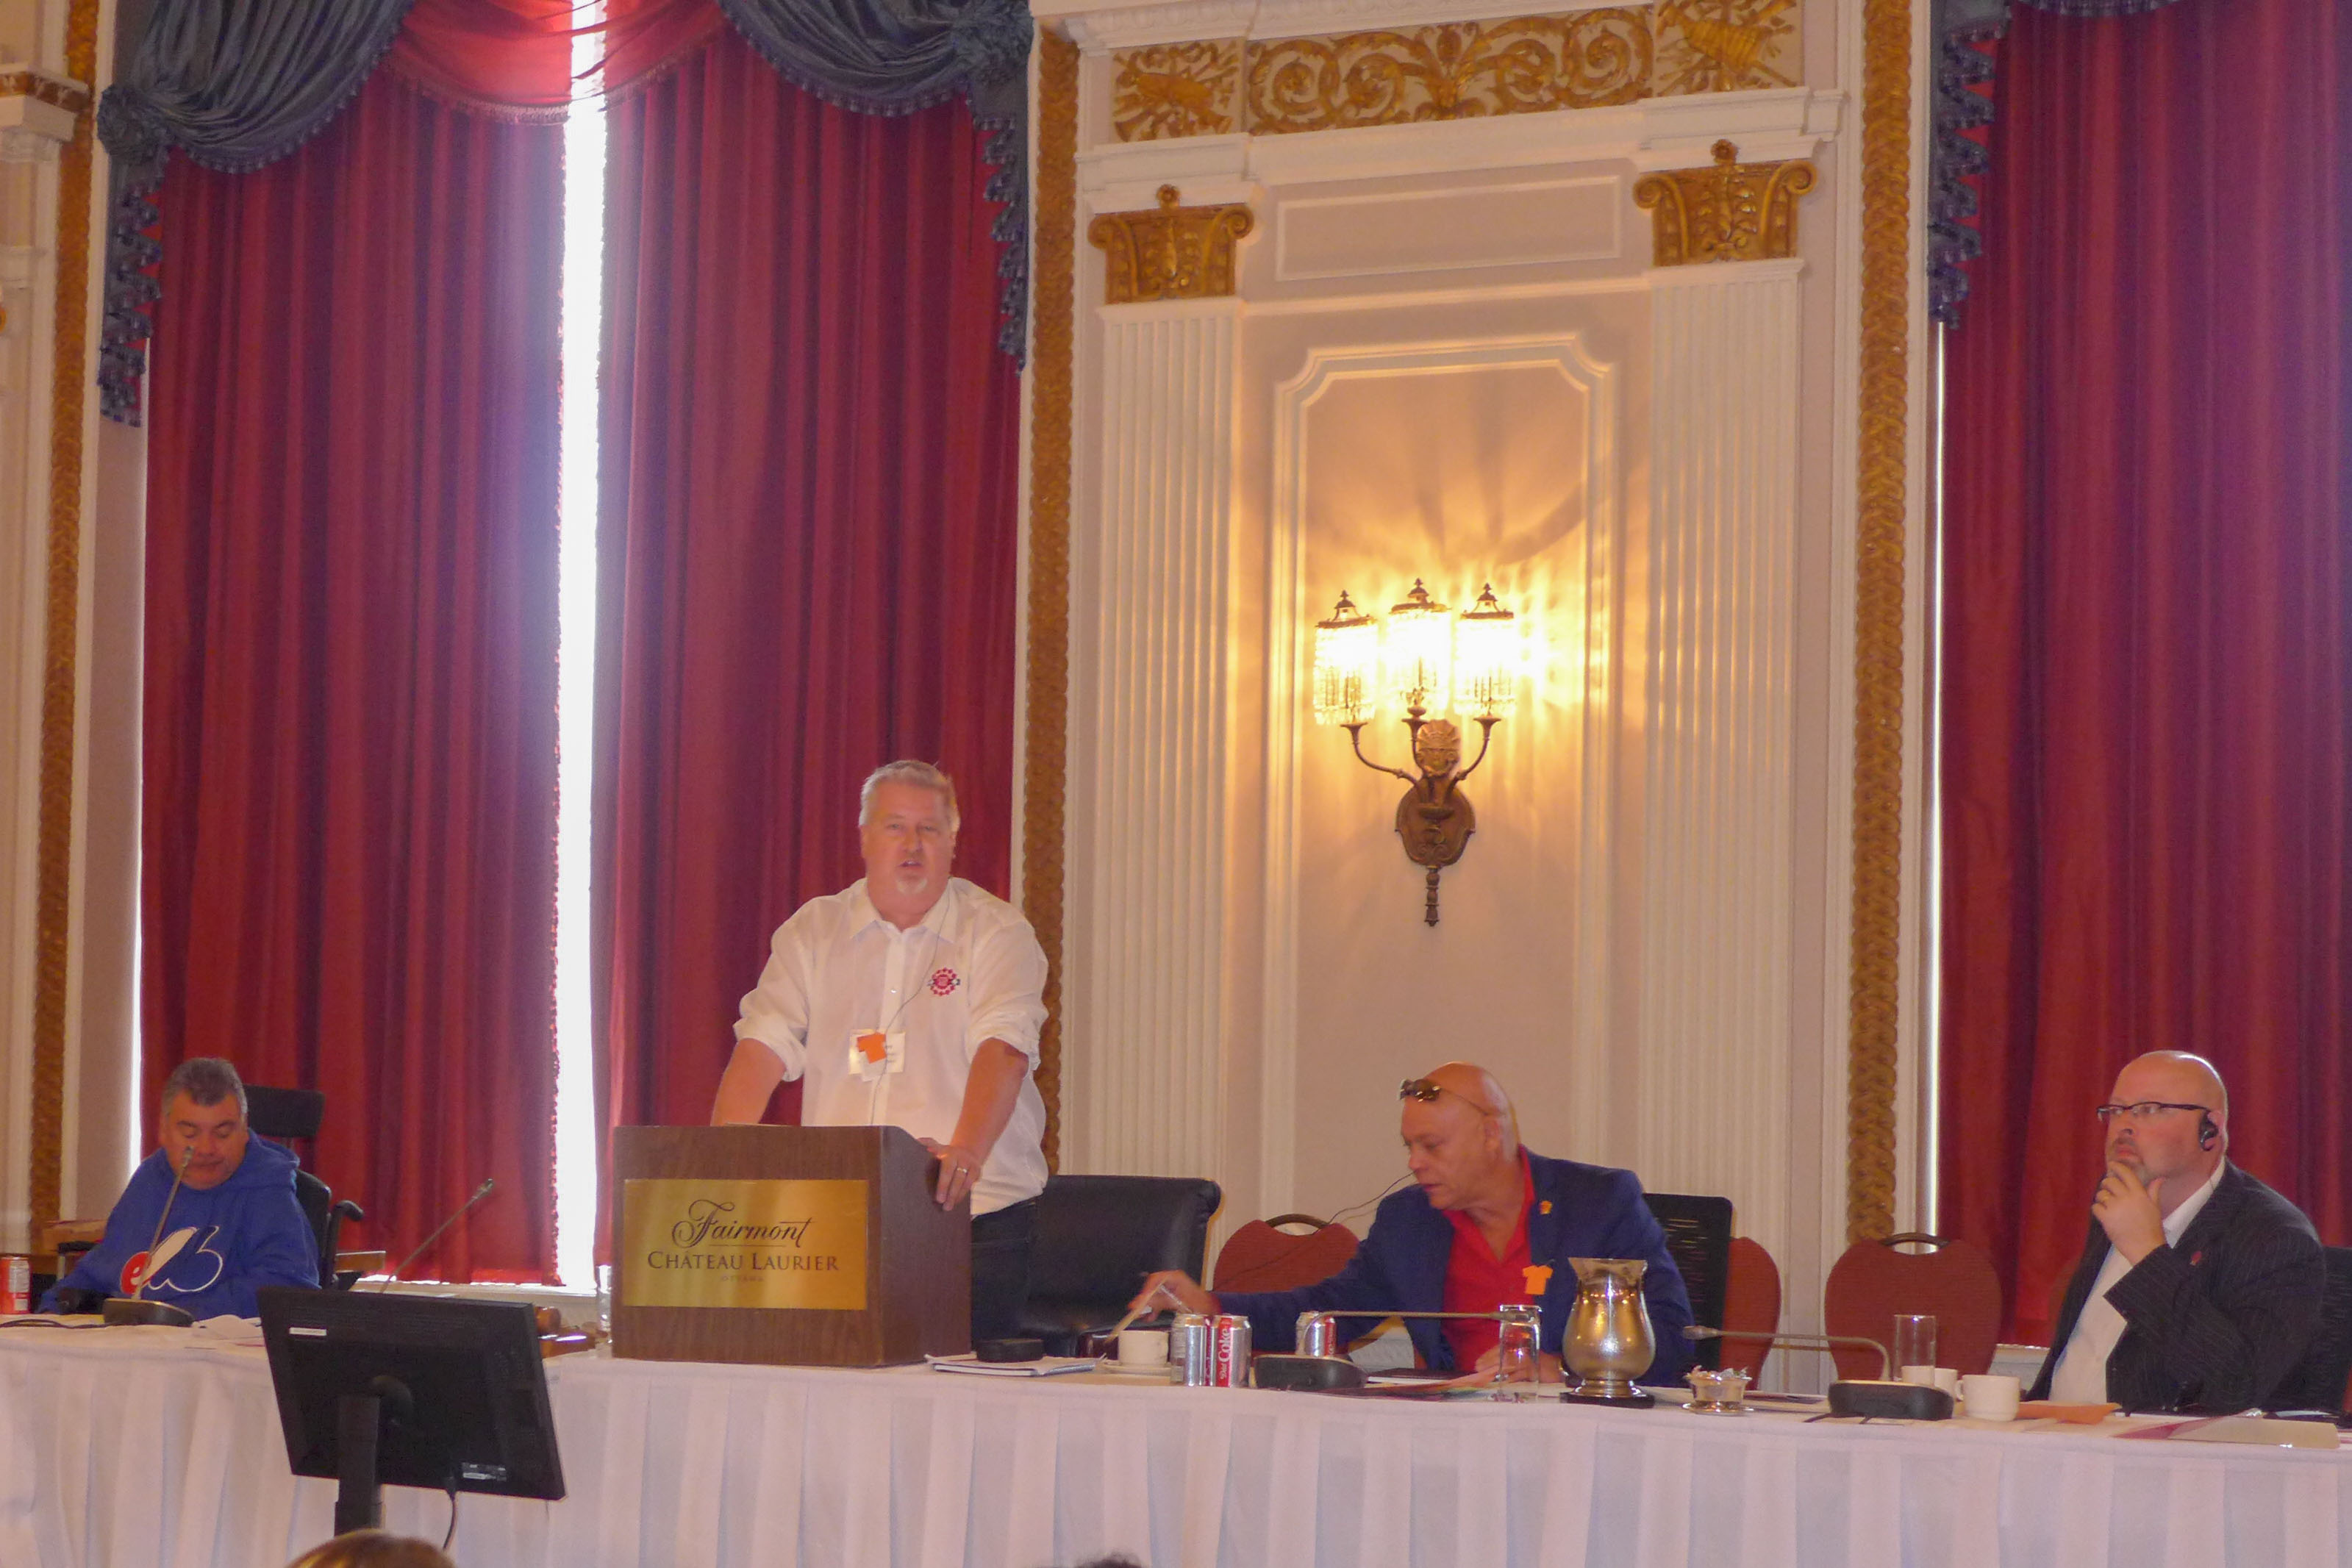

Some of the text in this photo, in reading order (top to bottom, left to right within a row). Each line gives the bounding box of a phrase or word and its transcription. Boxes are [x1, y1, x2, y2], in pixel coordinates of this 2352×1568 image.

[672, 1199, 815, 1248] Fairmont
[752, 1252, 839, 1270] LAURIER
[1218, 1328, 1230, 1362] Coke
